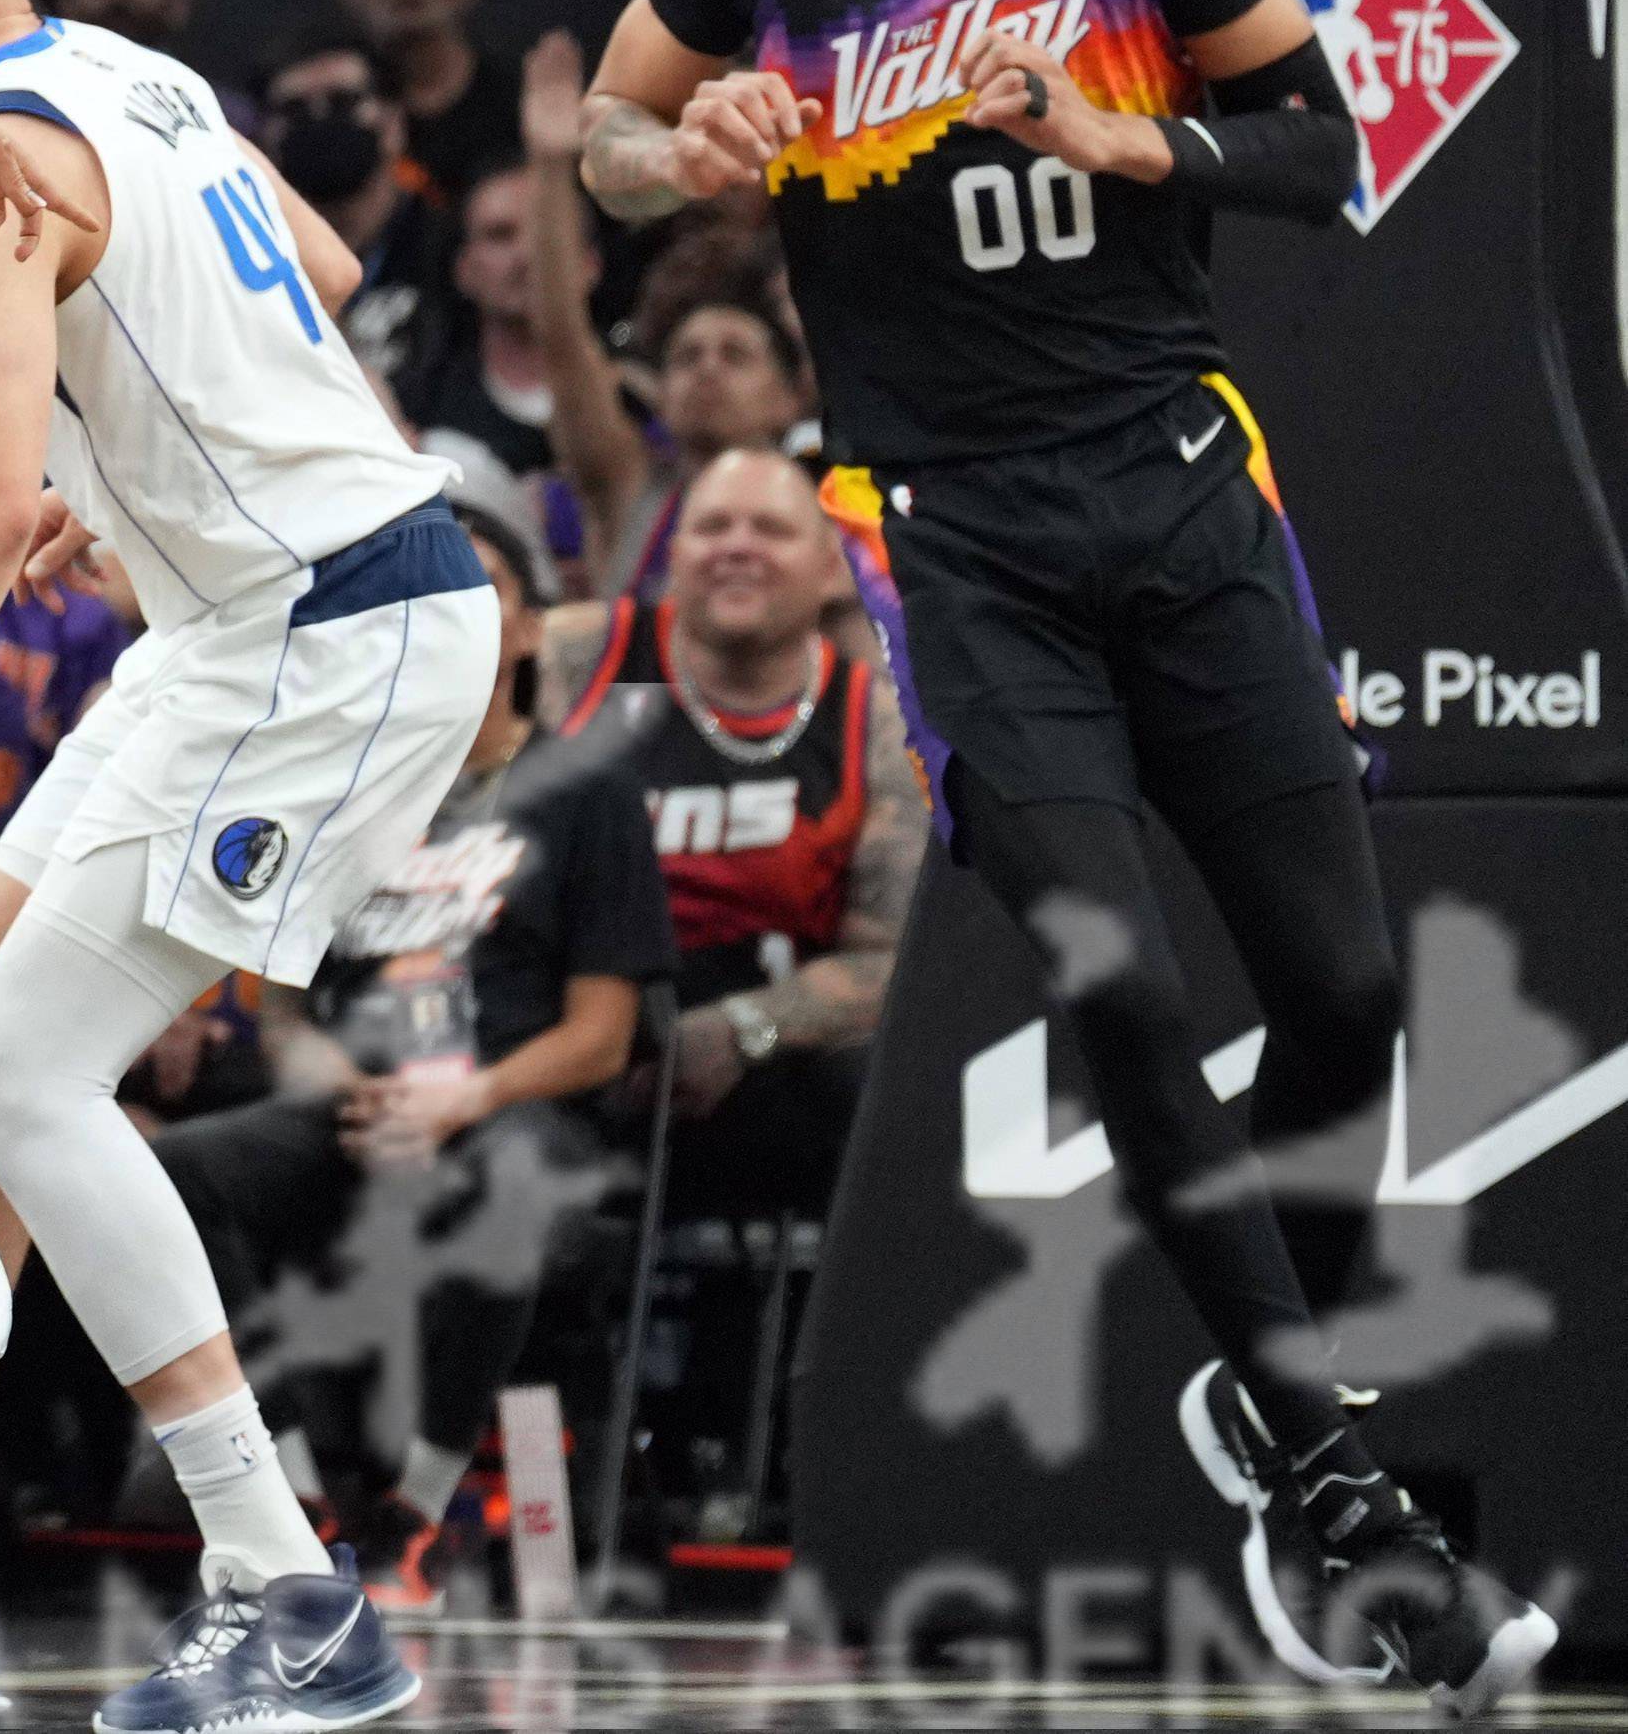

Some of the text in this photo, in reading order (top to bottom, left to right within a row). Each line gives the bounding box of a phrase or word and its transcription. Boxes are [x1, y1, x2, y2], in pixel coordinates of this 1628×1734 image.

[1392, 9, 1450, 87] 75
[950, 155, 1097, 273] 00
[1421, 646, 1602, 729] Pixel
